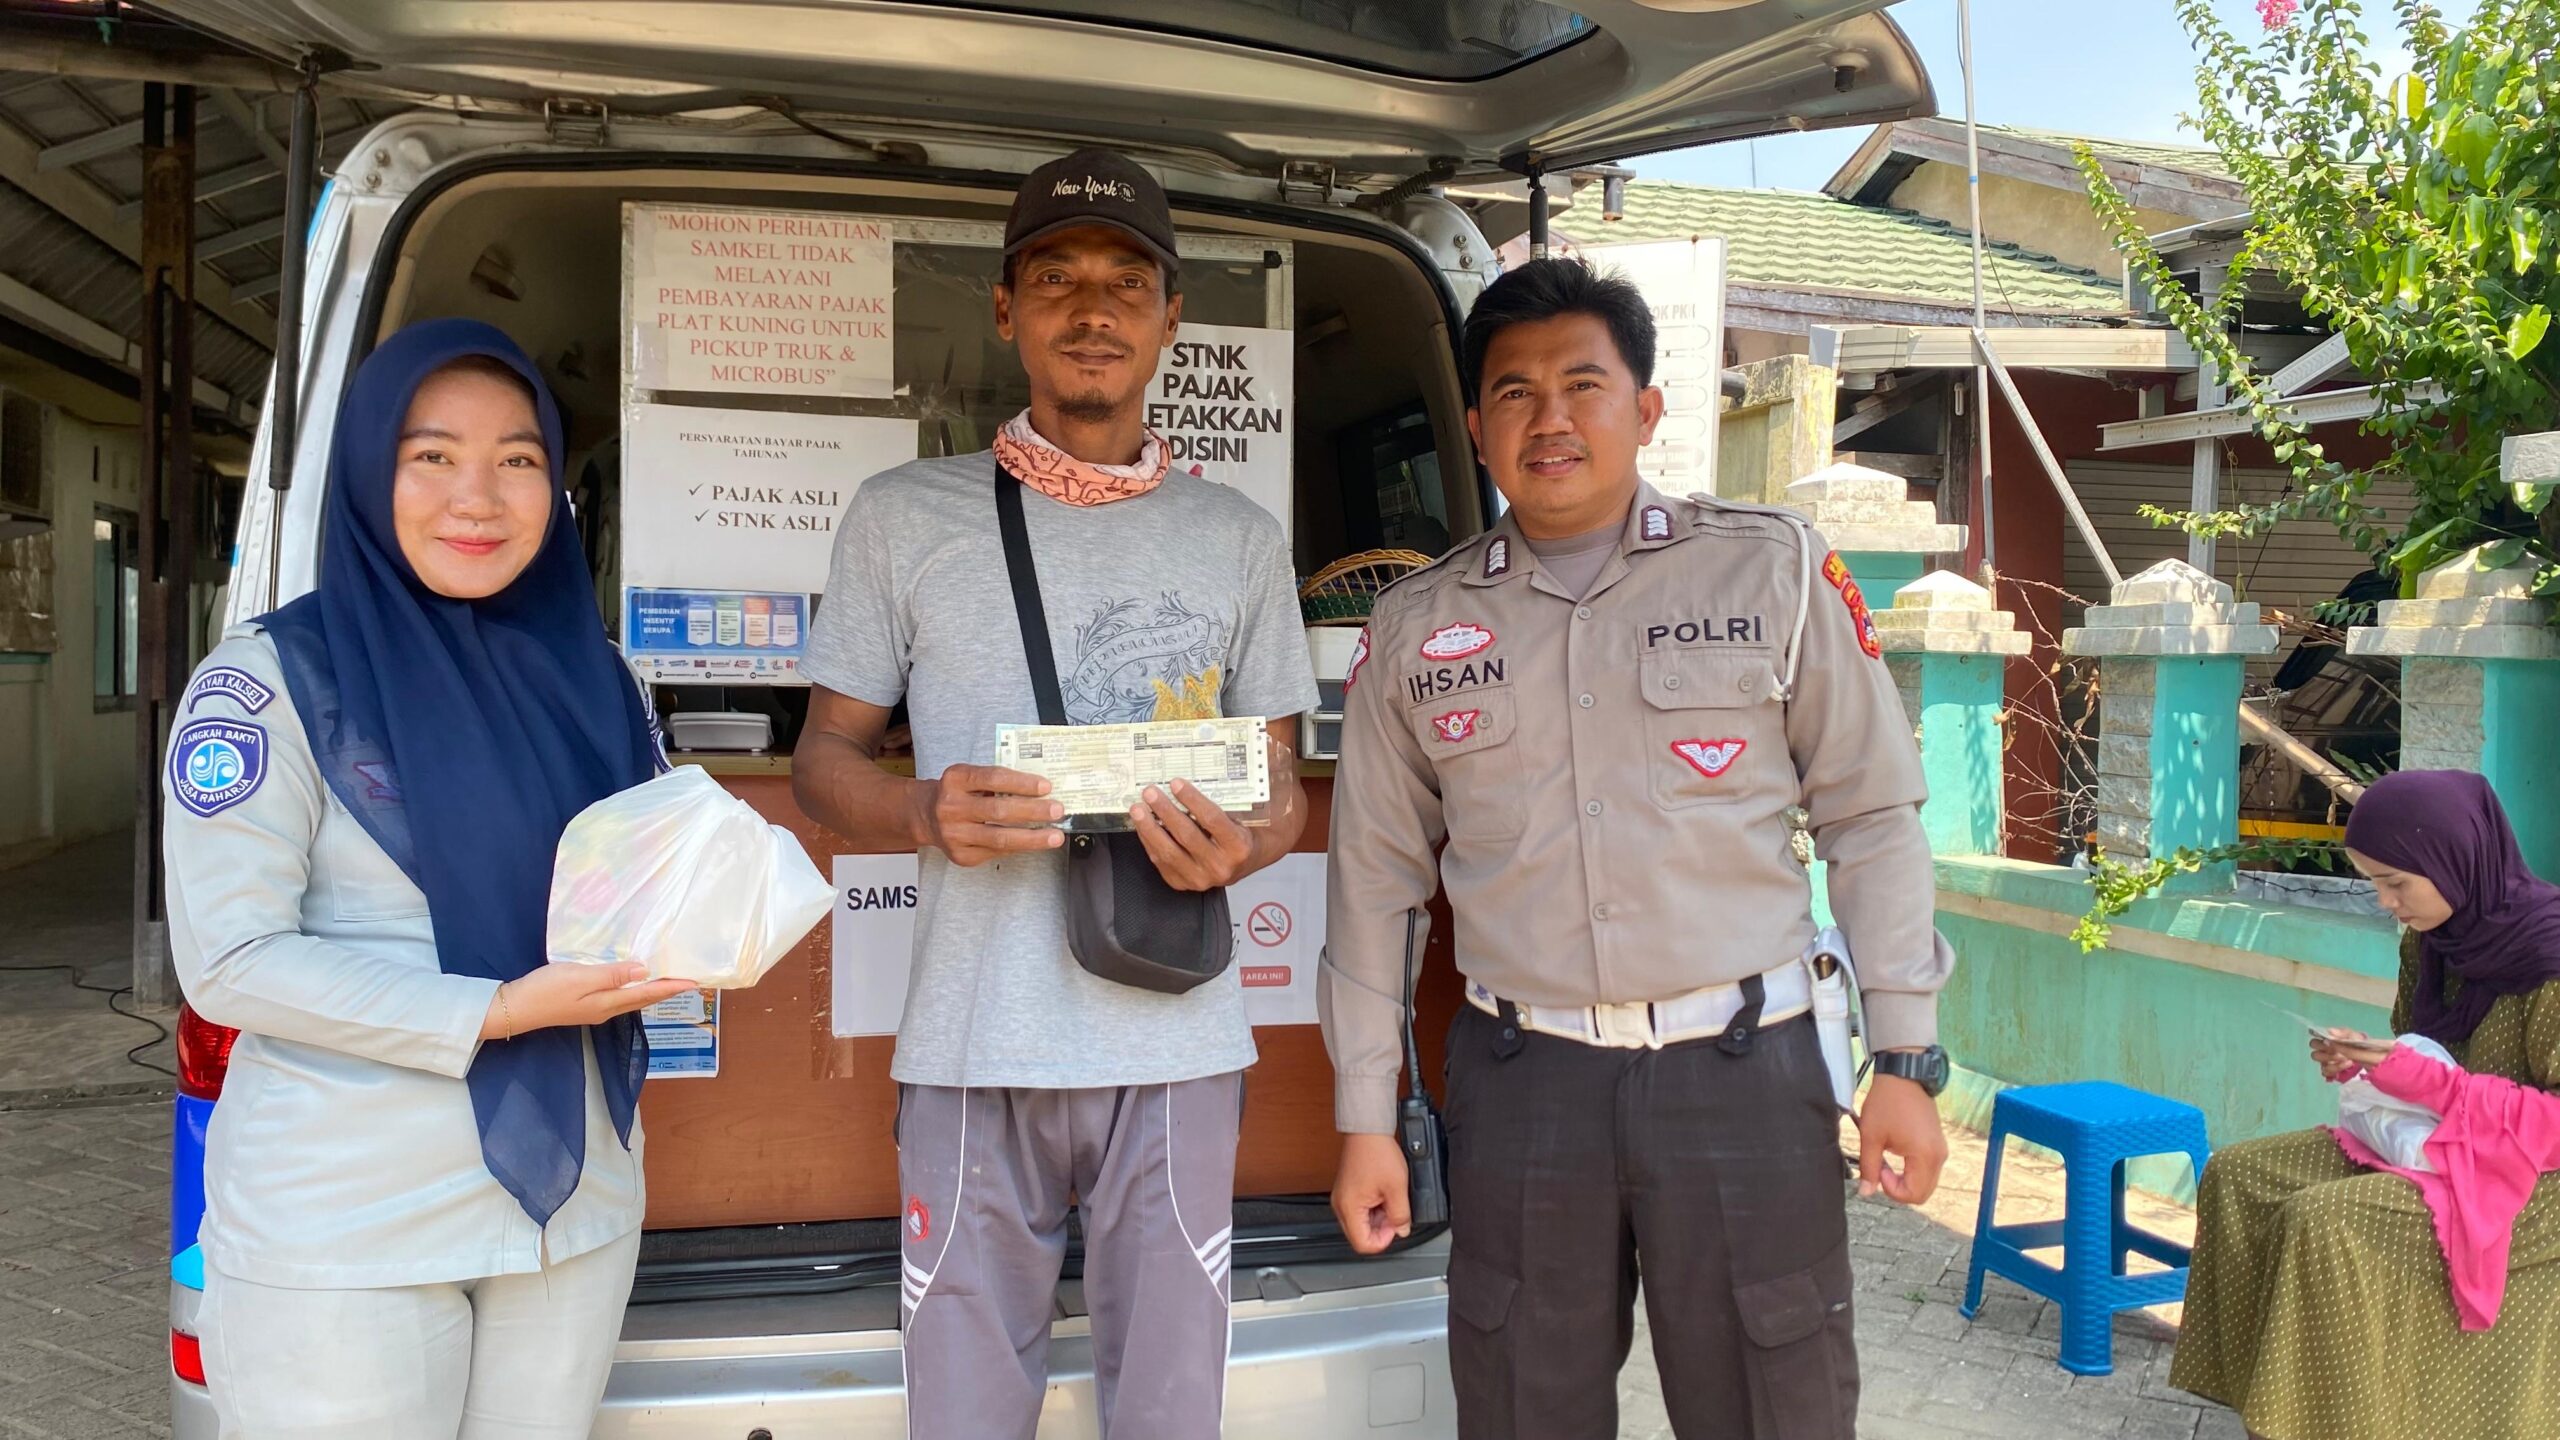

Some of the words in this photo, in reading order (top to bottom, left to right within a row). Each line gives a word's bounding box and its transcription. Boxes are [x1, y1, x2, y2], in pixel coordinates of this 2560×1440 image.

[1052, 178, 1081, 197] New
[1085, 175, 1118, 201] York
[758, 218, 886, 241] PERHATIAN,
[691, 240, 781, 261] SAMKEL
[787, 244, 855, 263] TIDAK
[715, 265, 832, 287] MELAYANI
[659, 288, 812, 311] PEMBAYARAN
[820, 295, 887, 314] PAJAK
[658, 313, 713, 331] PLAT
[720, 316, 806, 335] KUNING
[812, 319, 887, 339] UNTUK
[690, 339, 769, 358] PICKUP
[775, 342, 834, 361] TRUK
[840, 345, 857, 362] &
[1171, 342, 1247, 370] STNK
[1163, 373, 1255, 401] PAJAK
[679, 432, 762, 446] PERSYARATAN
[765, 437, 803, 448] BAYAR
[805, 439, 841, 450] PAJAK
[1168, 435, 1247, 462] DISINI
[733, 448, 788, 460] TAHUNAN
[713, 485, 783, 504] PAJAK
[790, 490, 839, 506] ASLI
[717, 511, 776, 530] STNK
[783, 515, 832, 532] ASLI
[639, 607, 681, 615] PEMBERIAN
[643, 626, 671, 634] BERUPA
[1647, 615, 1762, 647] POLRI
[226, 675, 260, 704] KALSEL
[1408, 657, 1504, 703] IHSAN
[183, 729, 222, 746] LANGKAH
[225, 730, 256, 745] BAKTI
[180, 778, 198, 801] JASA
[200, 778, 252, 804] RAHARJA
[847, 885, 918, 911] SAMS
[1246, 972, 1268, 981] AREA
